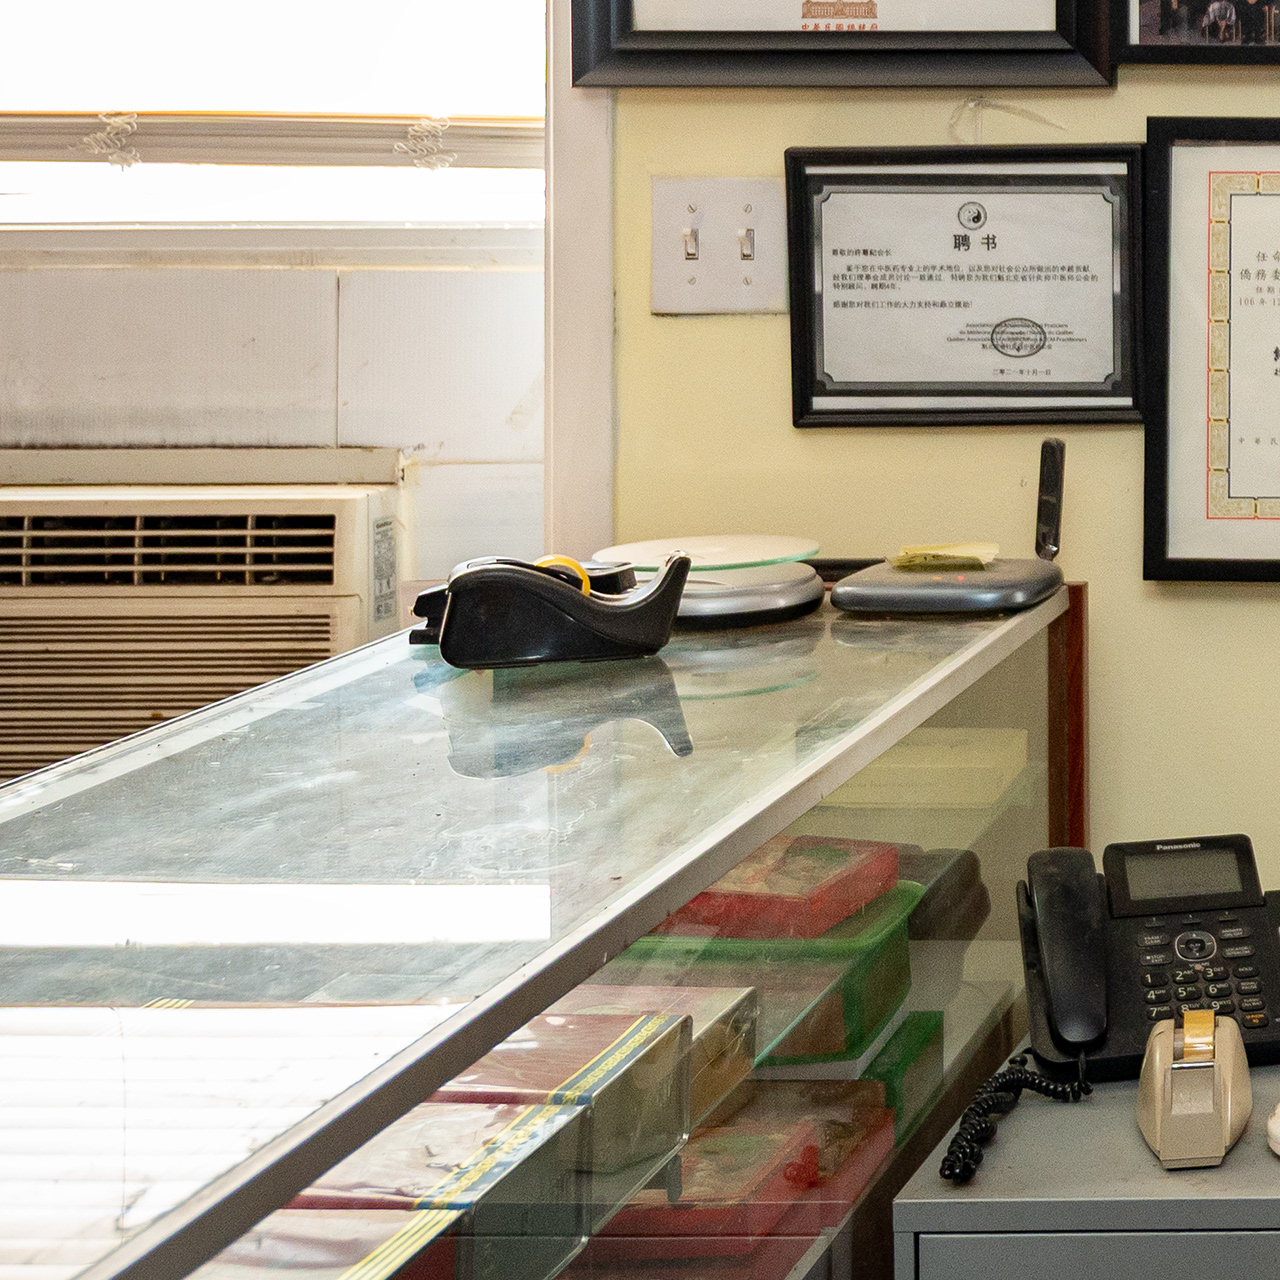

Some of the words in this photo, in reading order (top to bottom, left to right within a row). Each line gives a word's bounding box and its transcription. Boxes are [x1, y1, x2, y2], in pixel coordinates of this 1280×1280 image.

[953, 233, 997, 251] 聘书
[1156, 842, 1201, 851] Panasonic
[1175, 971, 1184, 980] 2
[1206, 968, 1214, 977] 3
[1145, 974, 1152, 983] 1
[1178, 988, 1187, 997] 5
[1209, 984, 1217, 994] 6
[1147, 990, 1156, 1000] 4
[1181, 1004, 1190, 1012] 8
[1211, 1001, 1220, 1010] 9
[1150, 1008, 1158, 1017] 7
